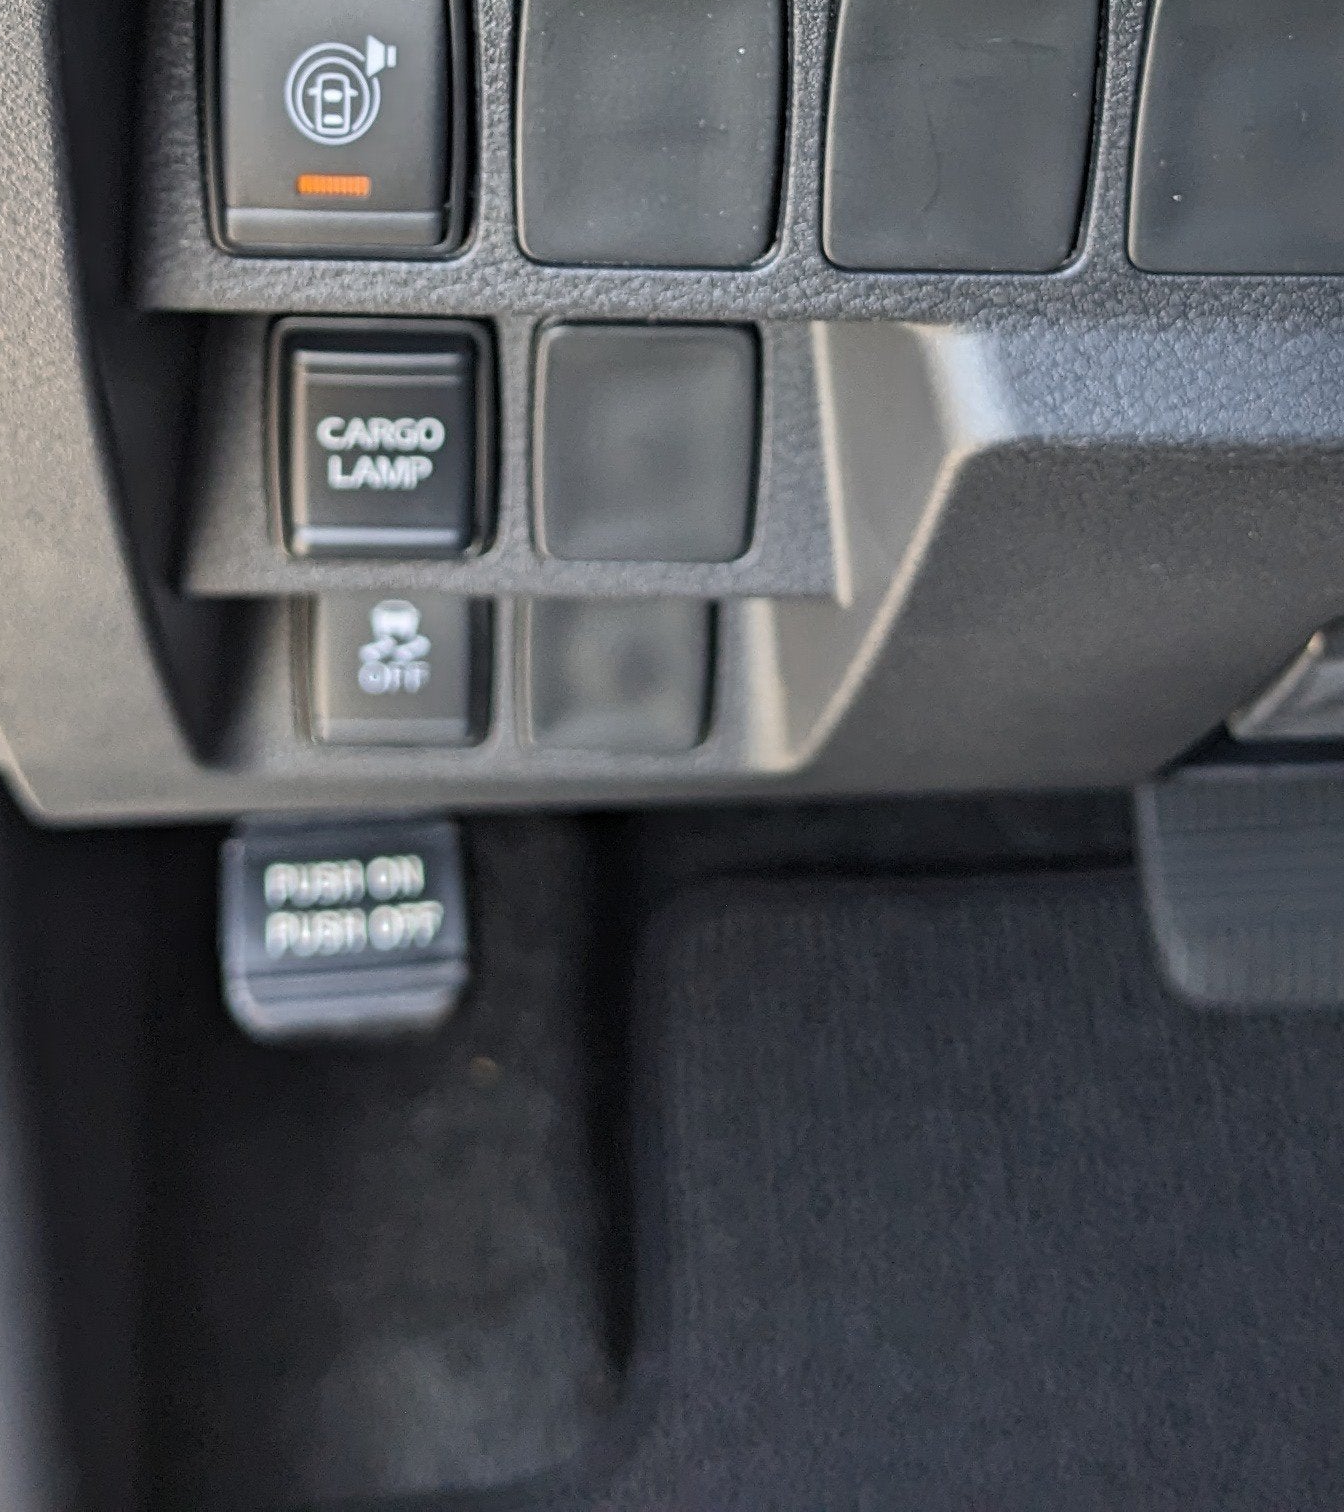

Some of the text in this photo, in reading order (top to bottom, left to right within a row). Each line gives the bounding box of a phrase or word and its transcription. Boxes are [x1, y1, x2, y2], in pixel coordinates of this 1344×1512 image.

[316, 416, 446, 452] CARGO
[327, 454, 434, 490] LAMP
[358, 660, 431, 694] OFF
[264, 854, 425, 908] PUSH ON
[265, 900, 444, 959] PUSH OFF
